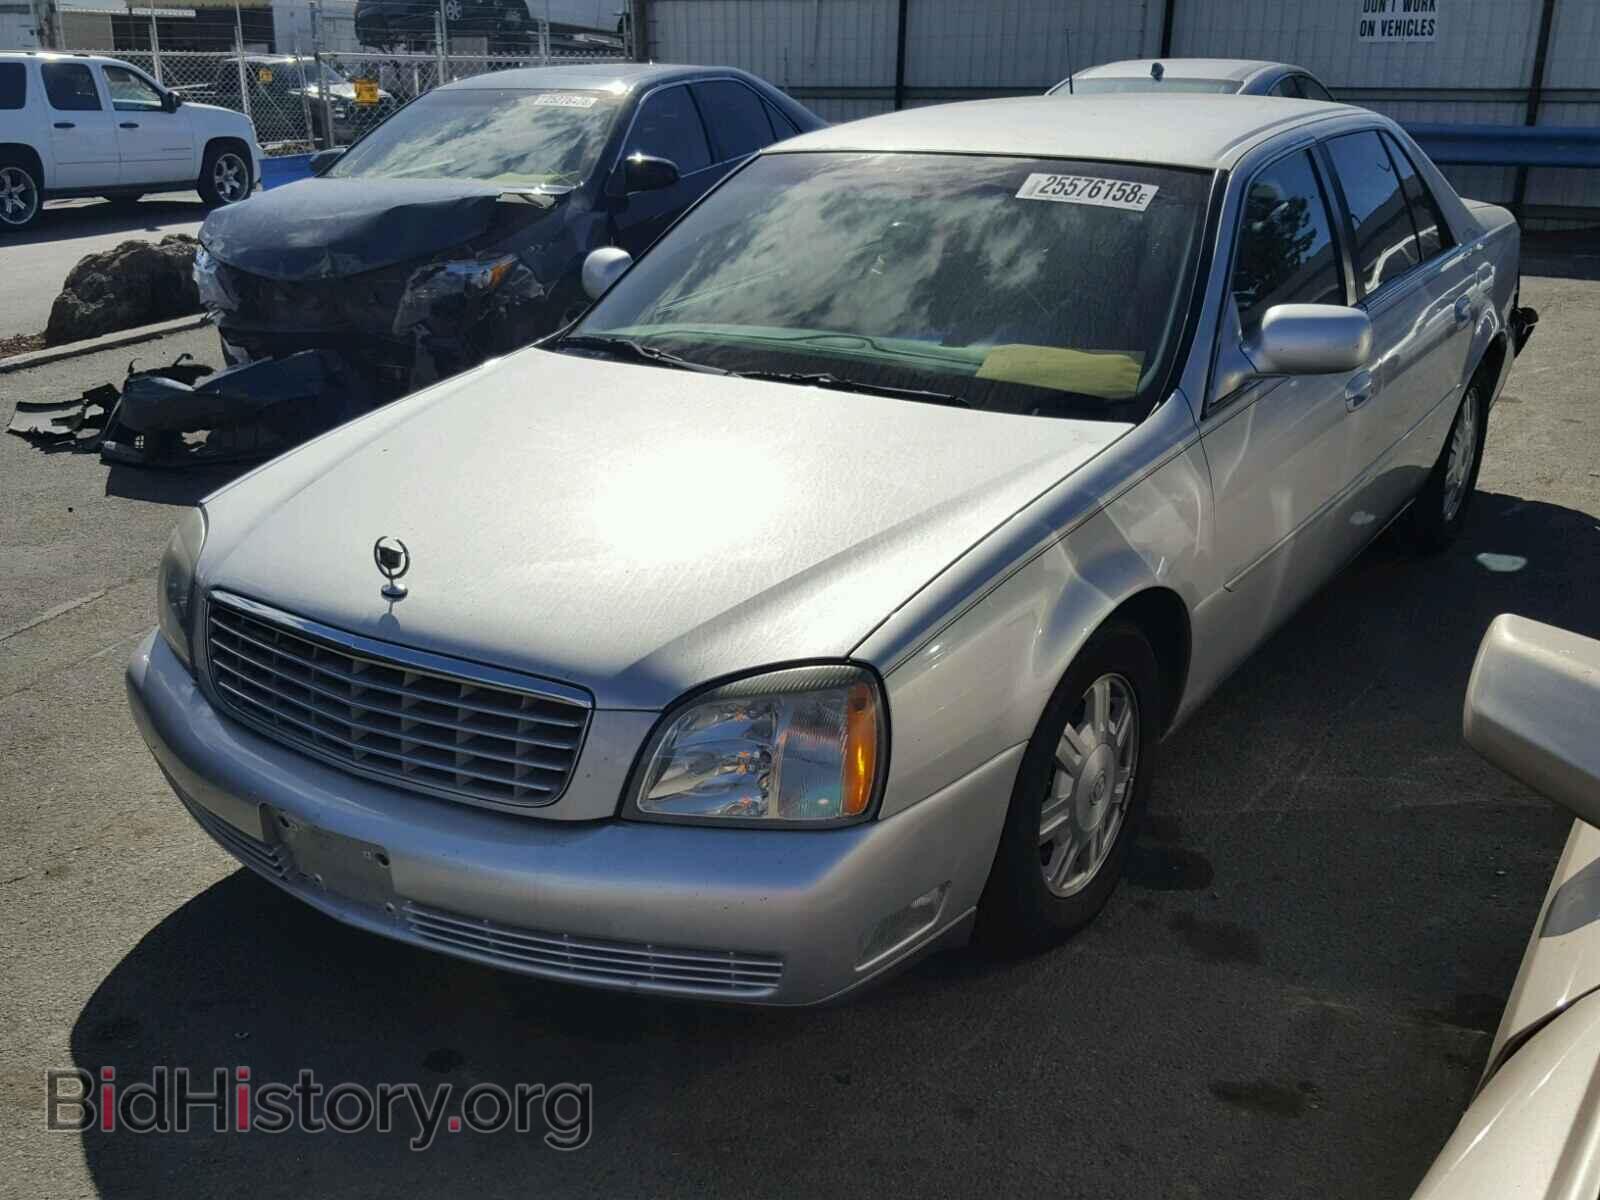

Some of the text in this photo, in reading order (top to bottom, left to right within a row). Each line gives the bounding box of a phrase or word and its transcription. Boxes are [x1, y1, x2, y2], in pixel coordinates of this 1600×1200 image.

[1363, 0, 1436, 13] DONT WORK
[1360, 18, 1435, 37] ON VEHICLES
